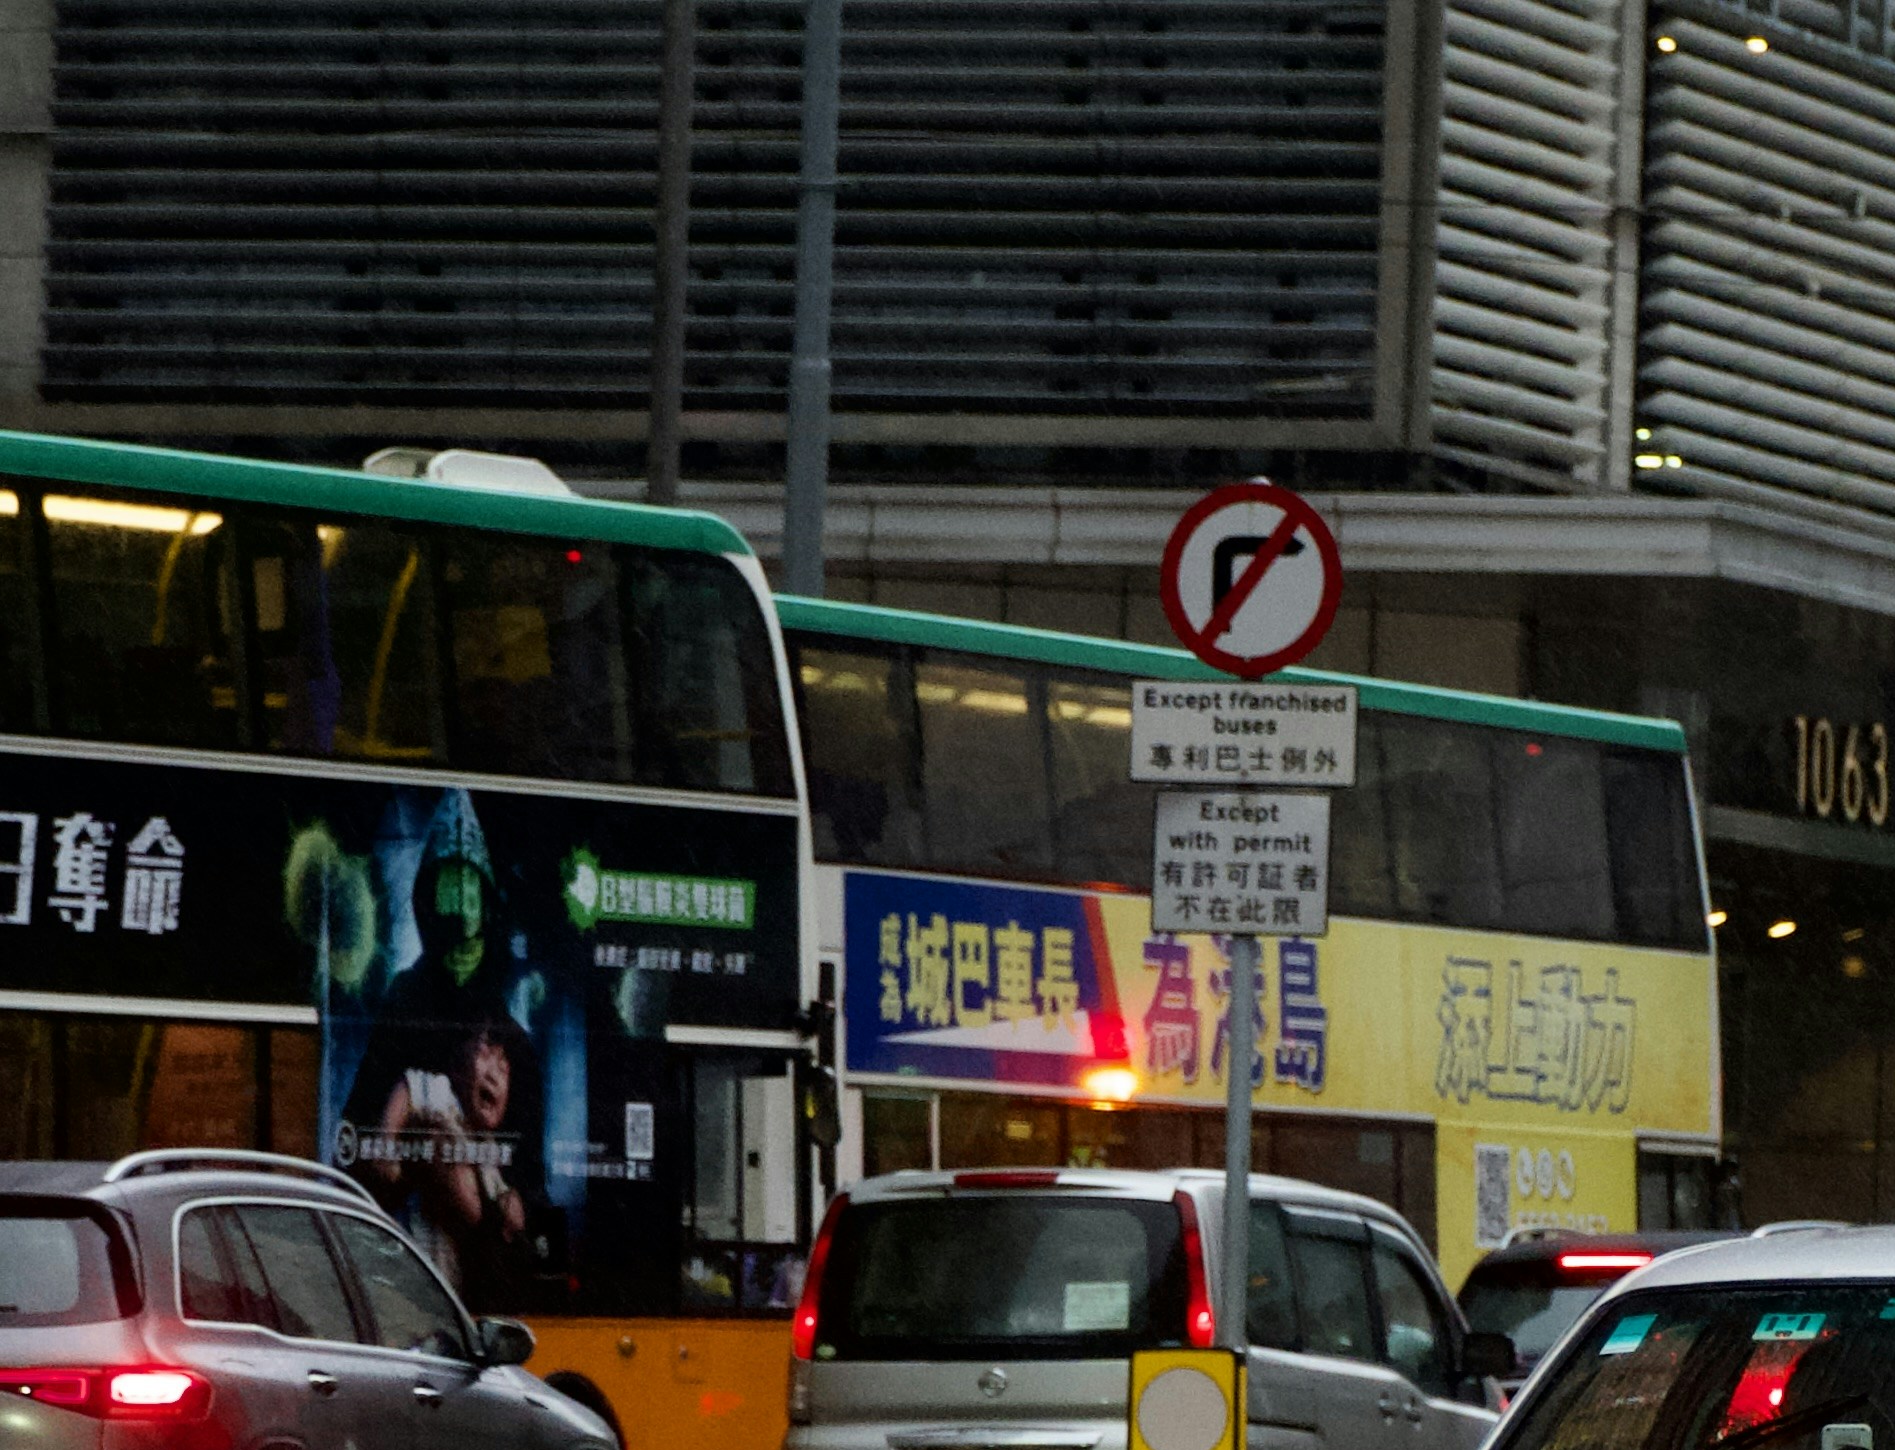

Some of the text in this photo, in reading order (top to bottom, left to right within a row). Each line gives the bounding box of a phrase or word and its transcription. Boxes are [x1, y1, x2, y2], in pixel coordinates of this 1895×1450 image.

[1143, 687, 1348, 713] Except franchised
[1213, 715, 1278, 736] buses
[1150, 742, 1338, 774] 專利巴士例外
[1794, 714, 1889, 825] 1063
[1200, 801, 1280, 824] Except
[1168, 831, 1313, 855] with permit
[1174, 894, 1300, 926] 不在此限
[906, 911, 1080, 1034] 城巴車長
